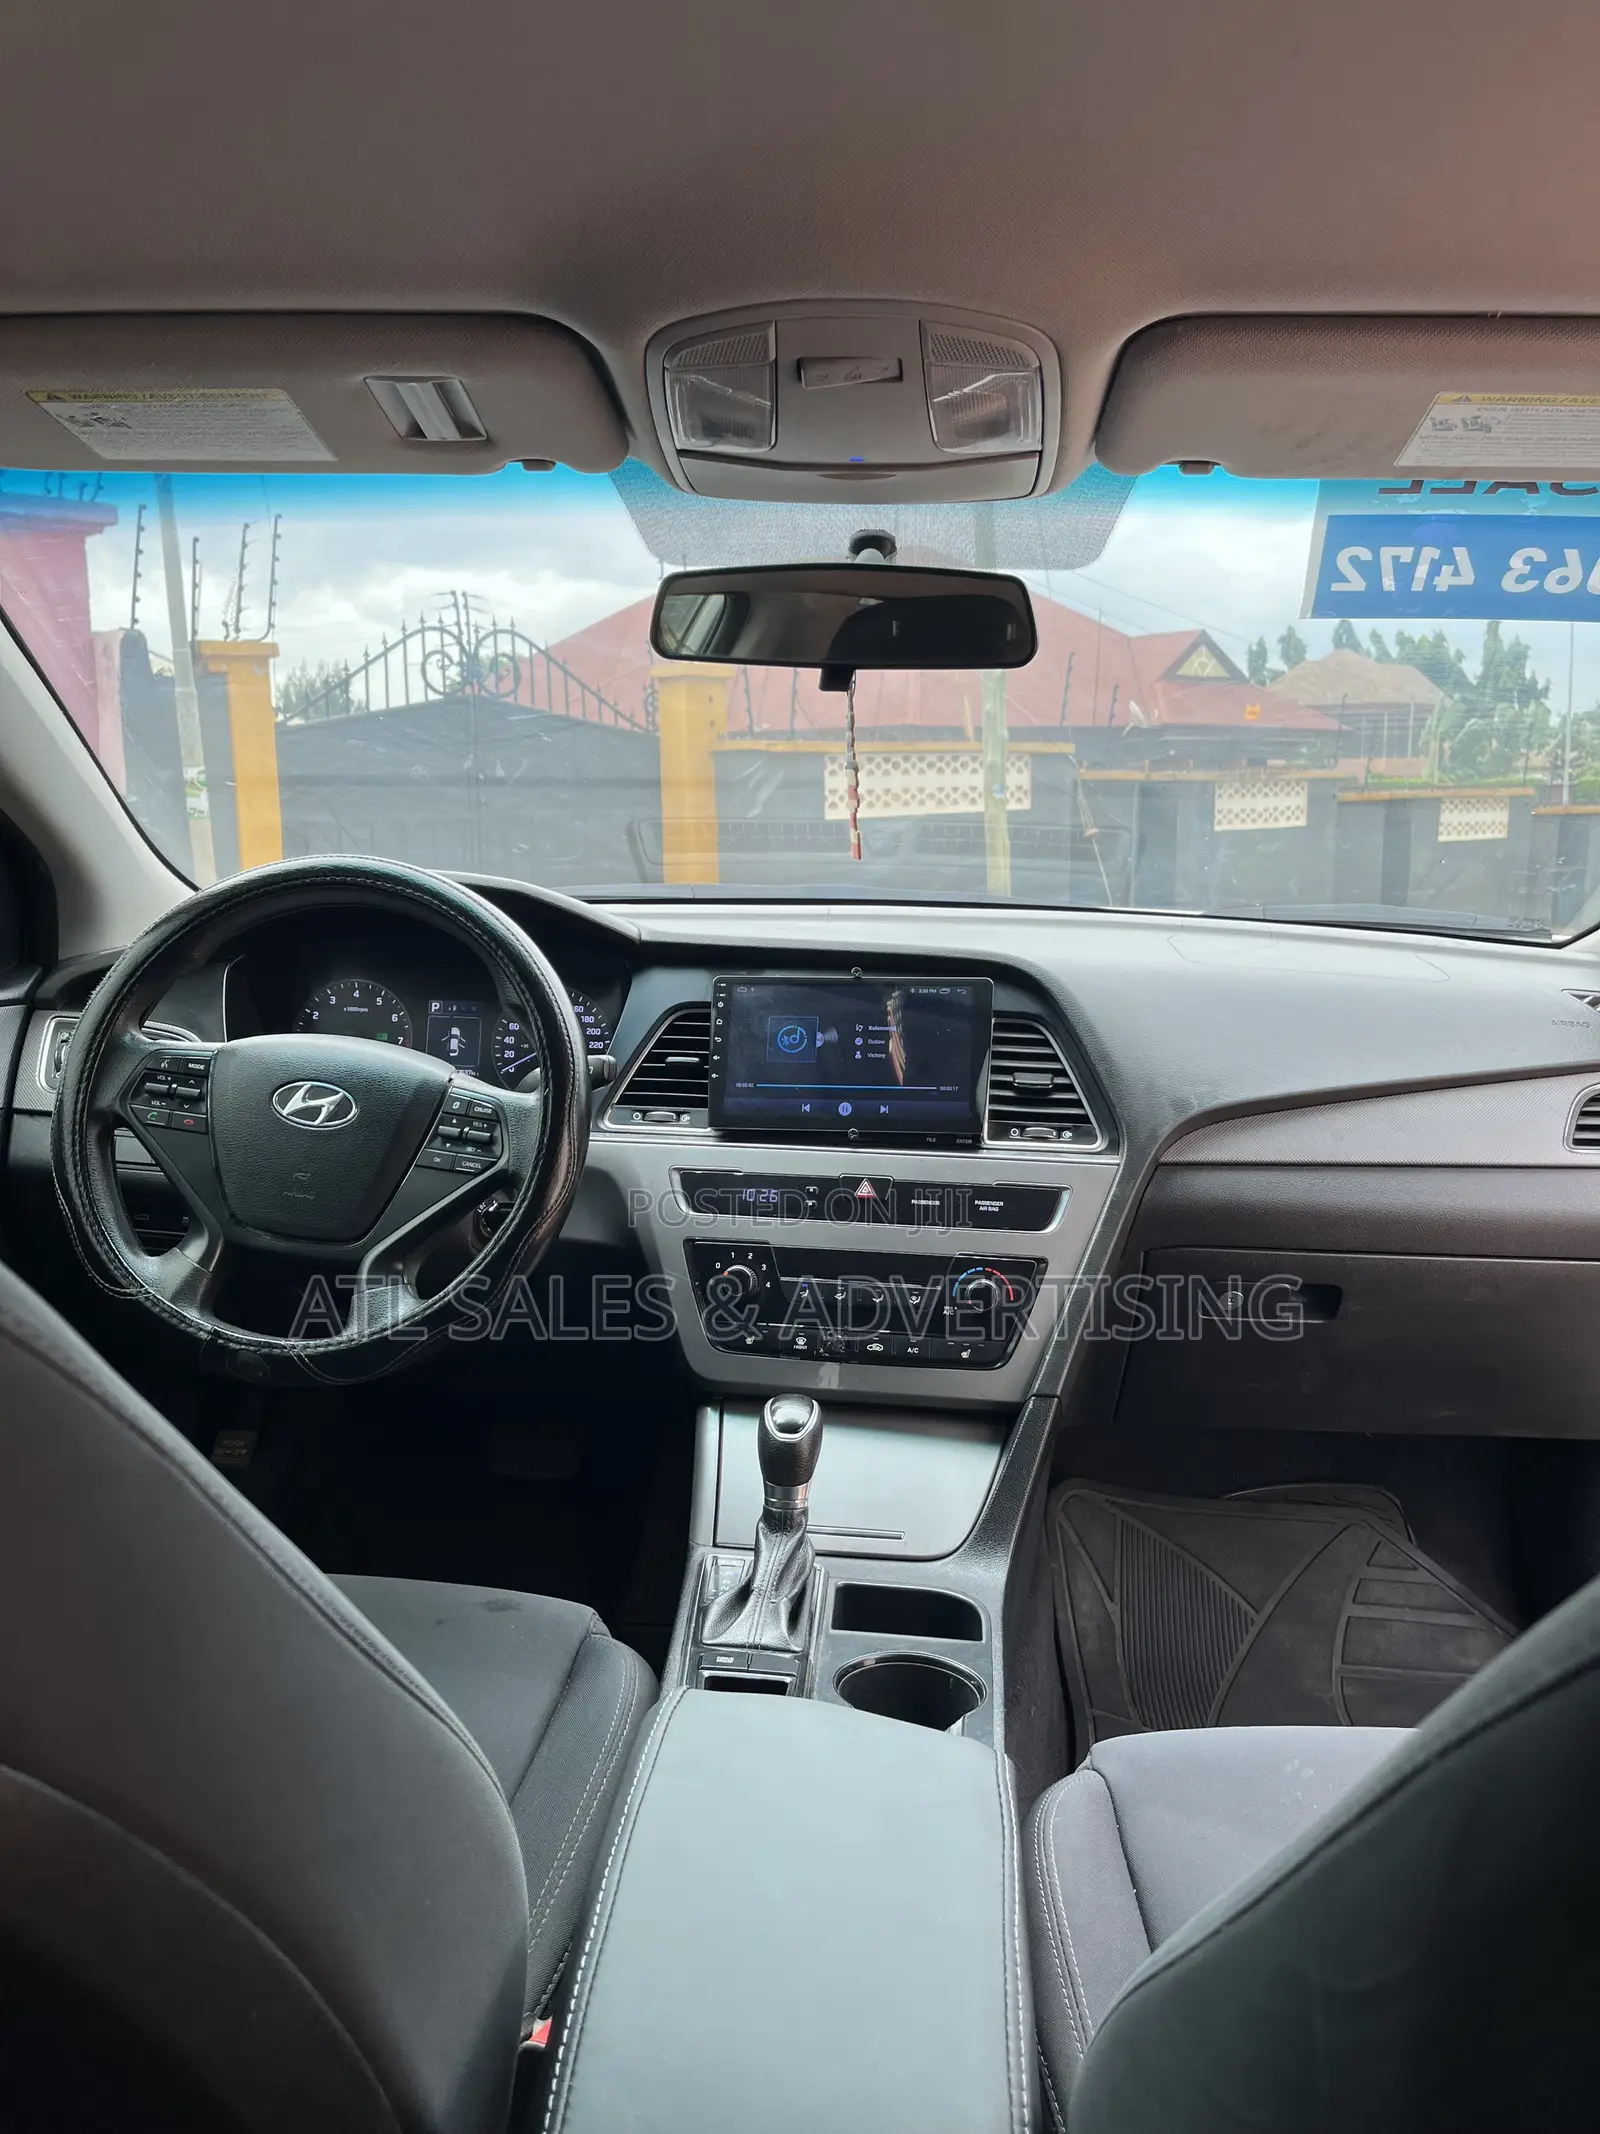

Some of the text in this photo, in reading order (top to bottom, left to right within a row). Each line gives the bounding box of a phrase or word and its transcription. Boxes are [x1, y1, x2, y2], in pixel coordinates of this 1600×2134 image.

[329, 996, 336, 1004] 3
[376, 997, 383, 1005] 5
[431, 1002, 440, 1012] P
[312, 1011, 319, 1019] 2
[391, 1014, 398, 1022] 6
[503, 1036, 515, 1044] 40
[588, 1041, 604, 1049] 220
[504, 1050, 515, 1058] 20
[188, 1062, 205, 1070] MODE
[474, 1106, 493, 1114] CRUISE
[461, 1161, 482, 1169] CANCEL
